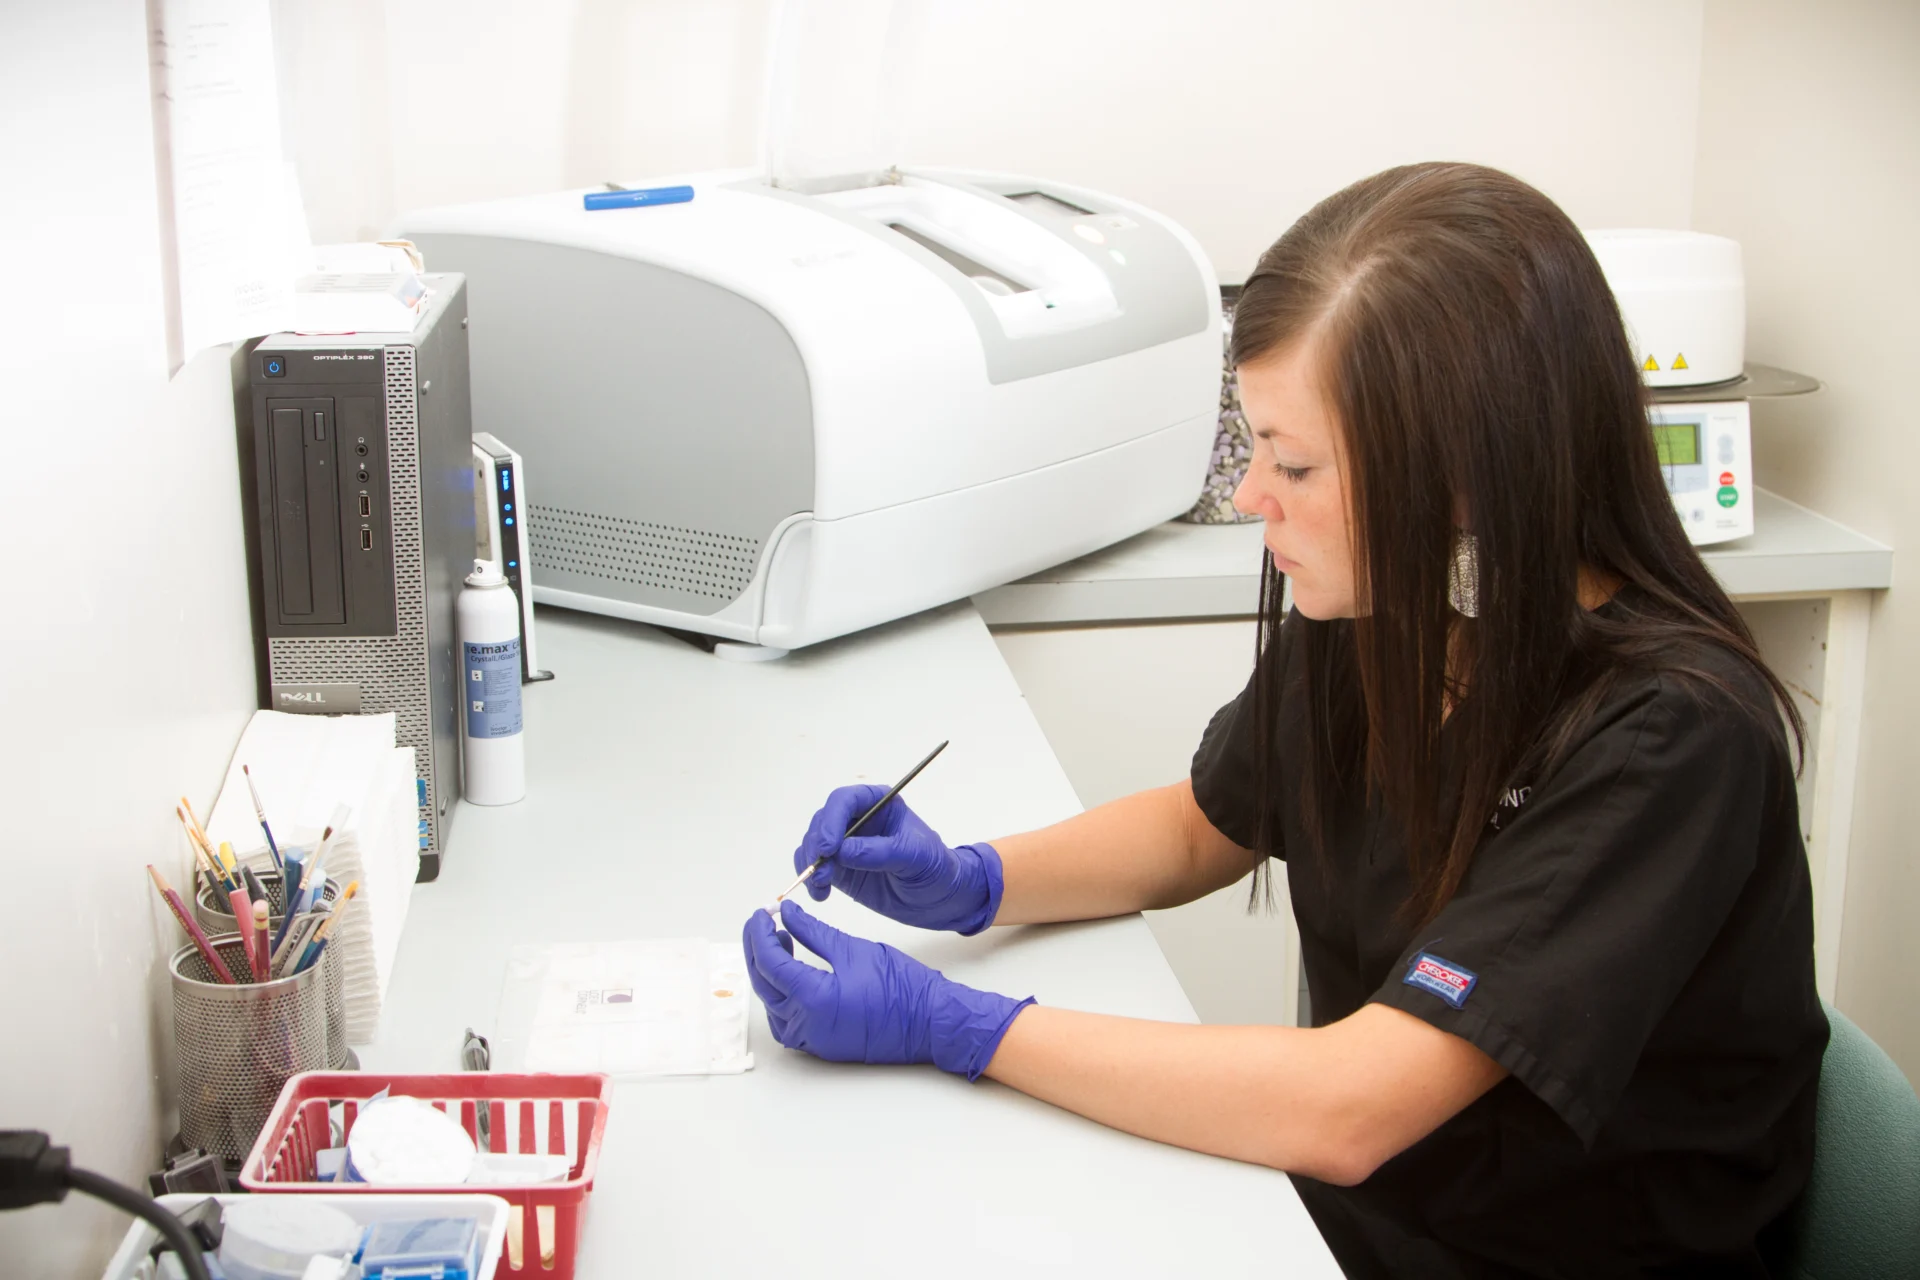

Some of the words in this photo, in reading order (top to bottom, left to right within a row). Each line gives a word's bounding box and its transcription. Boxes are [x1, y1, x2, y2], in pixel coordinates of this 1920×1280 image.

[281, 692, 326, 706] DELL
[1416, 973, 1457, 995] WORKWEAR
[1418, 962, 1464, 986] CHEROKEE
